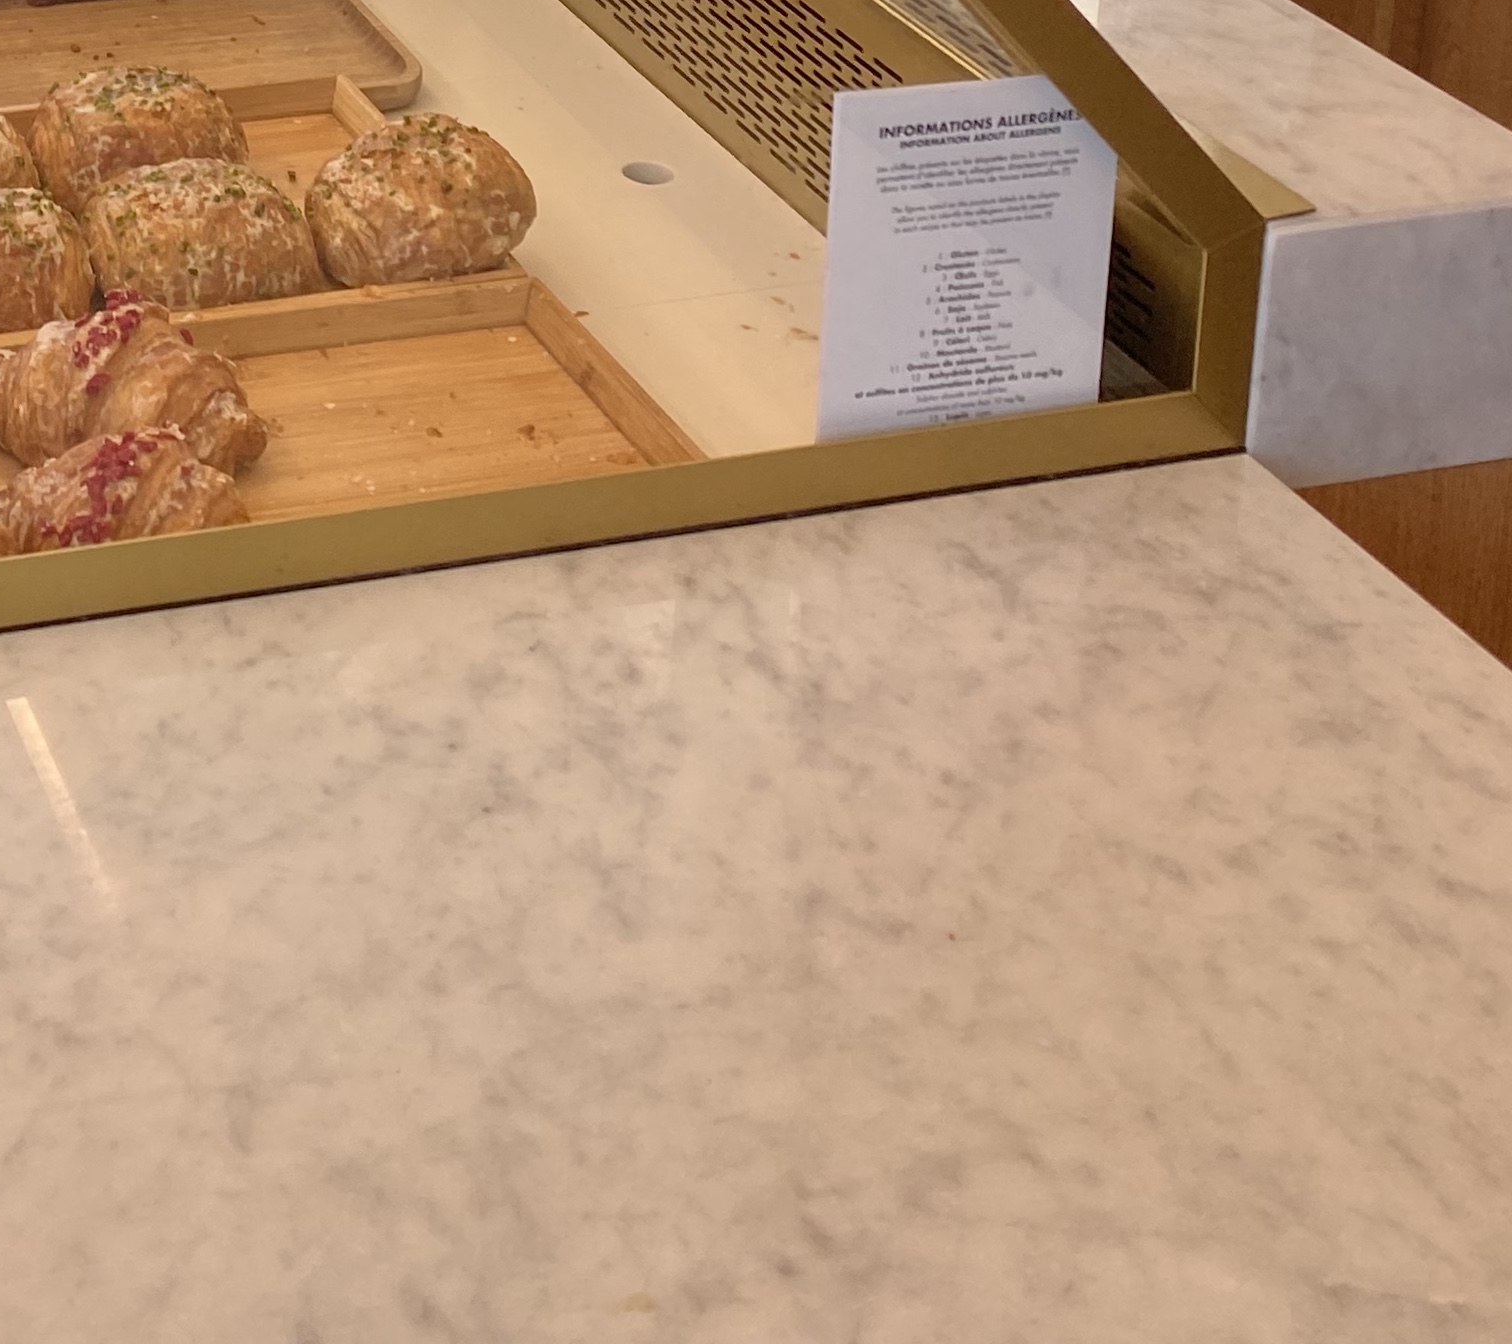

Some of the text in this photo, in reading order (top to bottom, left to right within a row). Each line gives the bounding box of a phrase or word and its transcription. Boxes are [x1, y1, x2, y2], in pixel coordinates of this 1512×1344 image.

[878, 117, 993, 140] INFORMATIONS
[899, 135, 970, 150] INFORMATION
[973, 131, 1007, 143] ABOUT
